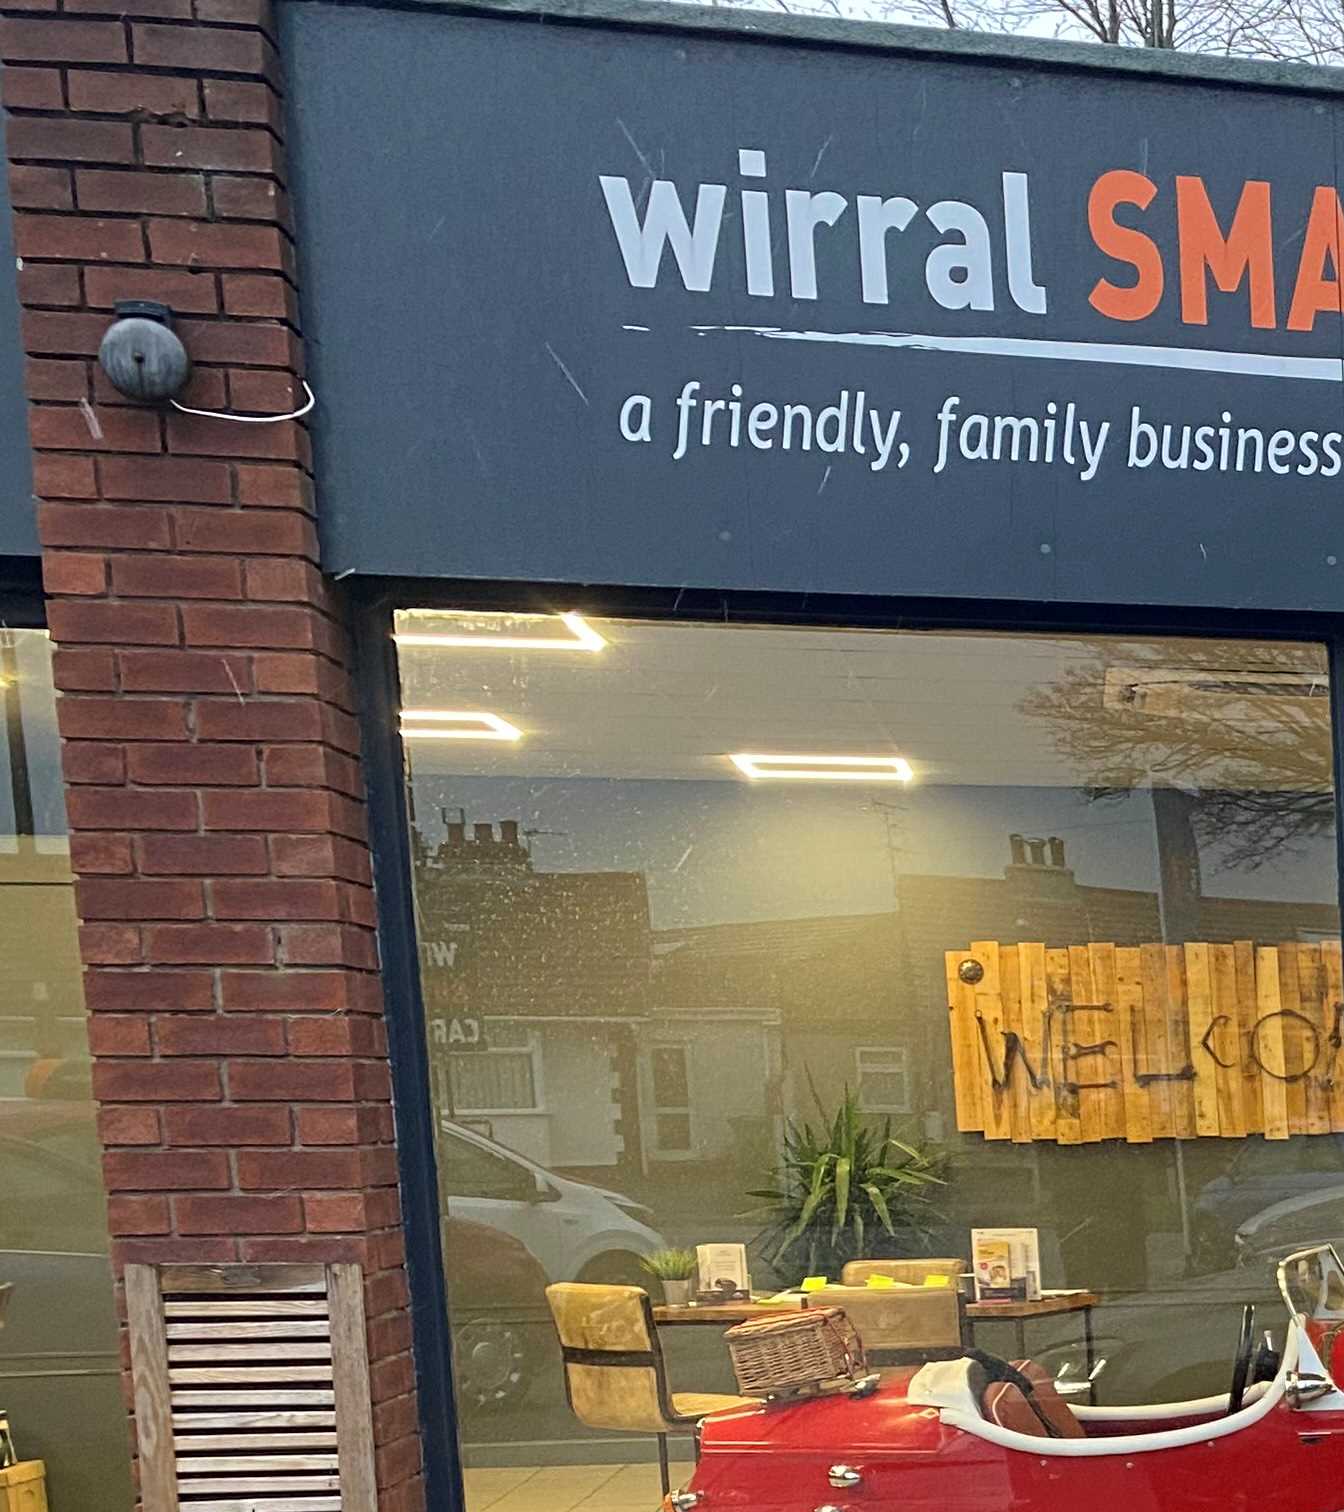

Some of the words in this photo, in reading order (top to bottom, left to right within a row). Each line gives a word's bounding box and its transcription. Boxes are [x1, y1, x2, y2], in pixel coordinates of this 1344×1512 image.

[600, 149, 1047, 314] wirral
[619, 394, 652, 443] a
[673, 381, 912, 472] friendly,
[933, 396, 1110, 481] family
[1127, 406, 1343, 477] business
